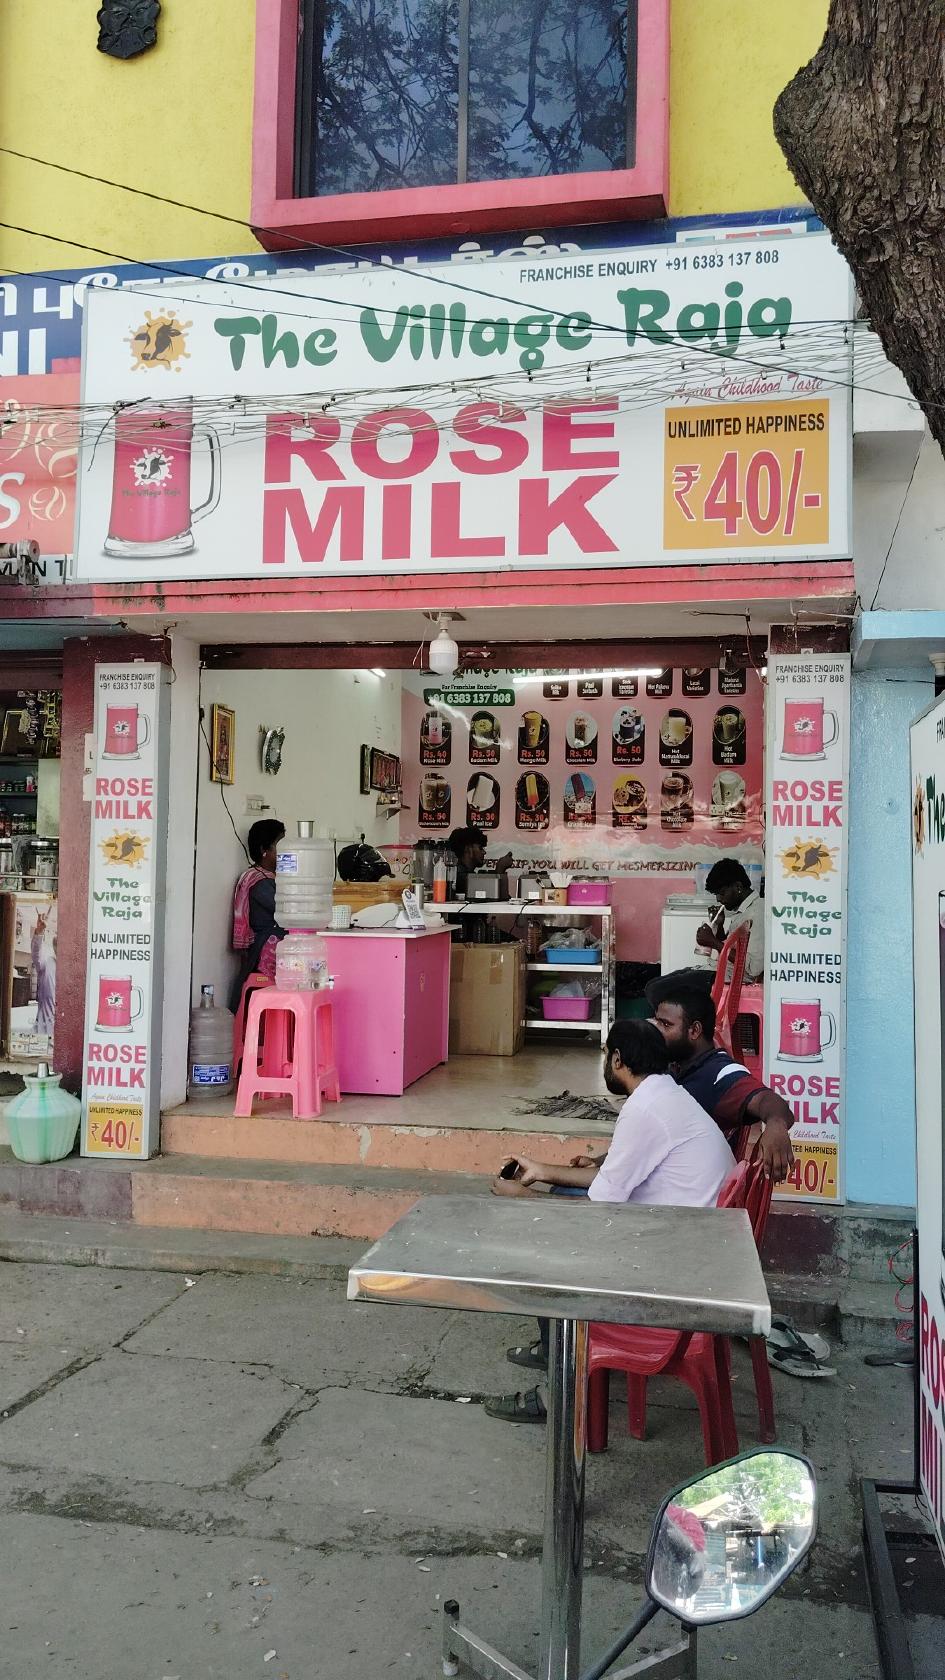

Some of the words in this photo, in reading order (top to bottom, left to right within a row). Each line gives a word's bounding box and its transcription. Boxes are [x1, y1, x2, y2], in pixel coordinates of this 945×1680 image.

[519, 263, 594, 283] FRANCHISE
[598, 259, 658, 277] ENQUIRY
[665, 256, 688, 271] +91
[692, 254, 724, 269] 6383
[728, 251, 751, 267] 137
[755, 249, 780, 264] 808
[213, 313, 339, 371] The
[359, 301, 593, 370] Village
[616, 280, 793, 355] Raja
[718, 375, 783, 400] Childhood
[787, 372, 824, 391] Taste
[668, 417, 742, 438] UNLIMITED
[745, 412, 825, 434] HAPPINESS
[263, 396, 620, 484] ROSE
[671, 447, 822, 538] ₹40/-
[262, 473, 620, 564] MILK
[775, 664, 813, 673] FRANCHISE
[815, 664, 845, 673] ENQUIRY
[99, 673, 131, 681] FRANCHISE
[131, 673, 155, 681] ENQUIRY
[775, 675, 789, 683] +91
[792, 675, 811, 683] 6383
[813, 675, 827, 683] 137
[829, 675, 845, 683] 808
[99, 682, 111, 690] +91
[112, 682, 129, 690] 6383
[130, 682, 142, 690] 137
[143, 682, 155, 690] 808
[447, 693, 471, 704] 6383
[472, 693, 491, 703] 137
[492, 693, 511, 703] 808
[631, 746, 641, 754] 50
[95, 777, 154, 796] ROSE
[772, 780, 843, 802] ROSE
[94, 799, 153, 820] MILK
[772, 804, 843, 827] MILK
[560, 860, 589, 870] WILL
[592, 861, 615, 872] GET
[105, 877, 140, 889] The
[93, 891, 153, 907] Village
[787, 890, 828, 903] The
[101, 906, 143, 920] Raja
[771, 906, 842, 922] Village
[781, 922, 832, 938] Raja
[91, 933, 151, 945] UNLIMITED
[90, 948, 151, 961] HAPPINESS
[770, 952, 842, 966] UNLIMITED
[770, 969, 842, 984] HAPPINESS
[88, 1042, 147, 1064] ROSE
[86, 1066, 146, 1089] MILK
[769, 1073, 841, 1098] ROSE
[787, 1100, 841, 1125] ILK
[804, 1145, 837, 1155] HAPPINESS
